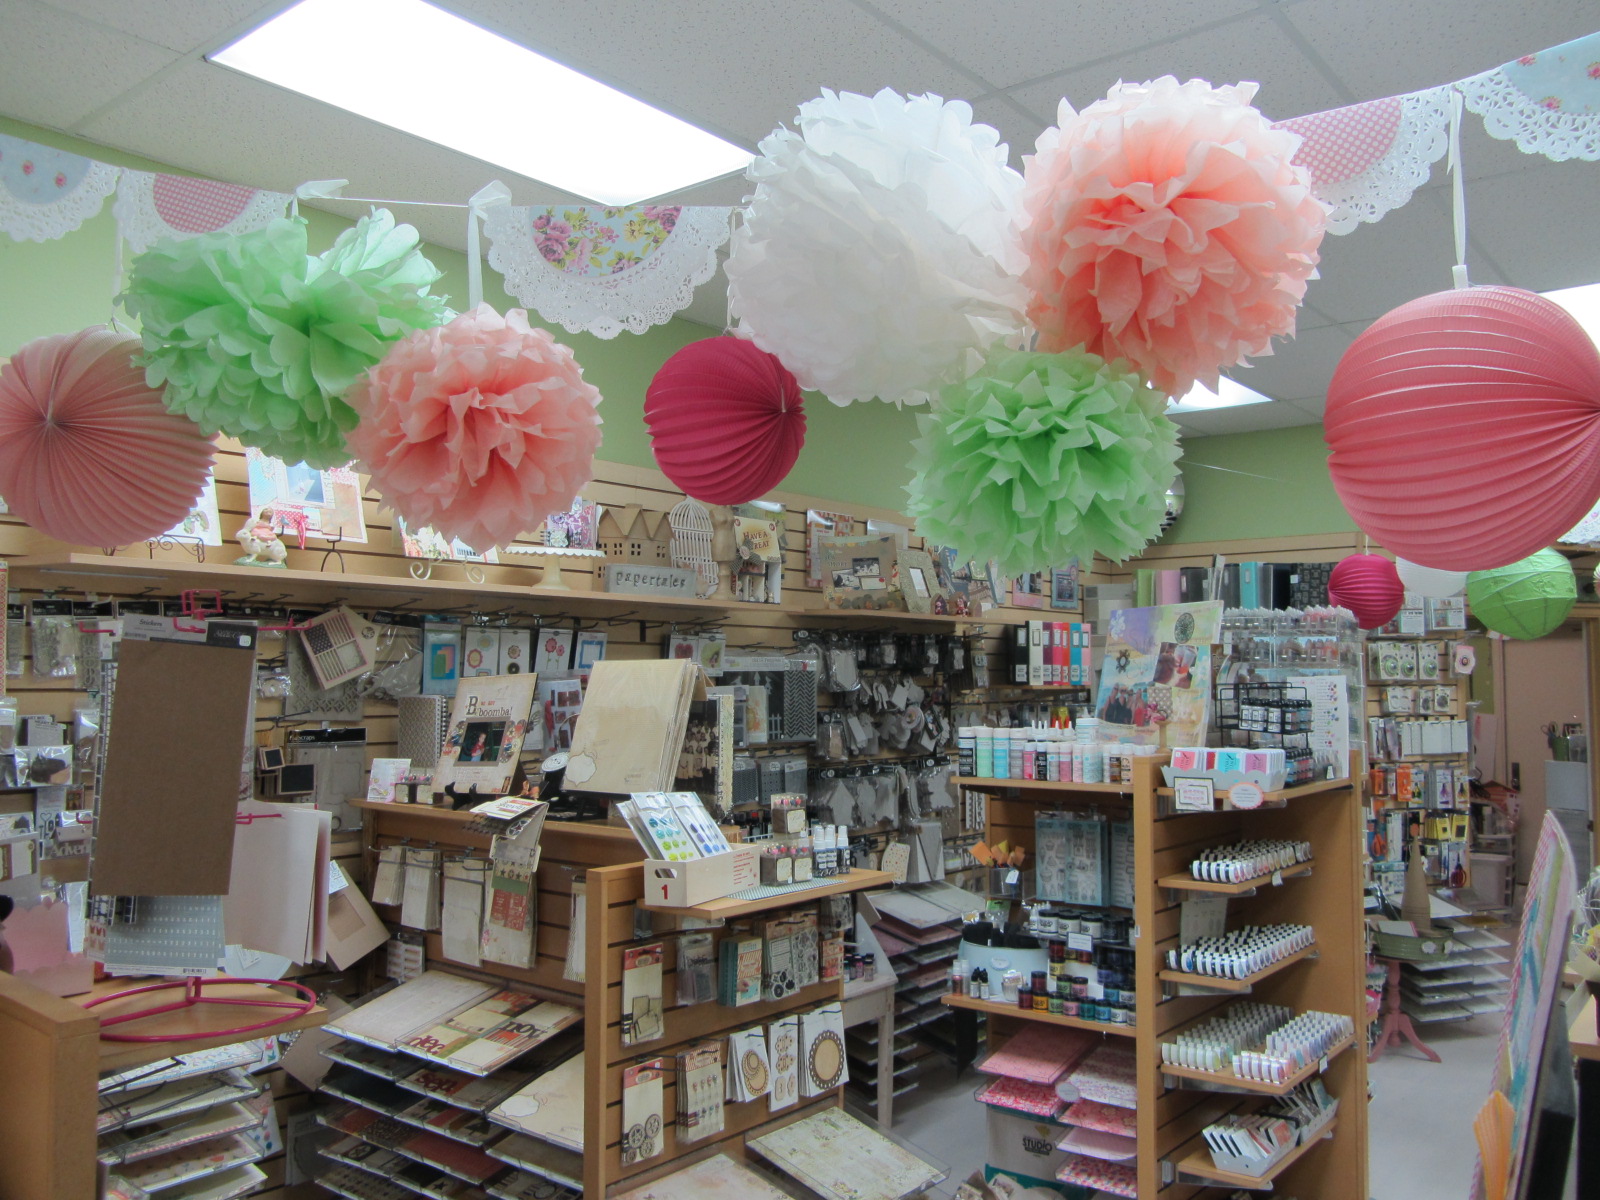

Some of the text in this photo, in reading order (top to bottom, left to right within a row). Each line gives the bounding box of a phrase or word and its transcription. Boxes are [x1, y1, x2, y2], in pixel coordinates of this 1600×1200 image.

[743, 531, 762, 540] HAVE
[750, 541, 770, 549] REAT
[616, 571, 687, 588] papertales
[139, 617, 163, 627] Stickers
[660, 884, 669, 900] 1
[407, 1035, 446, 1055] dec
